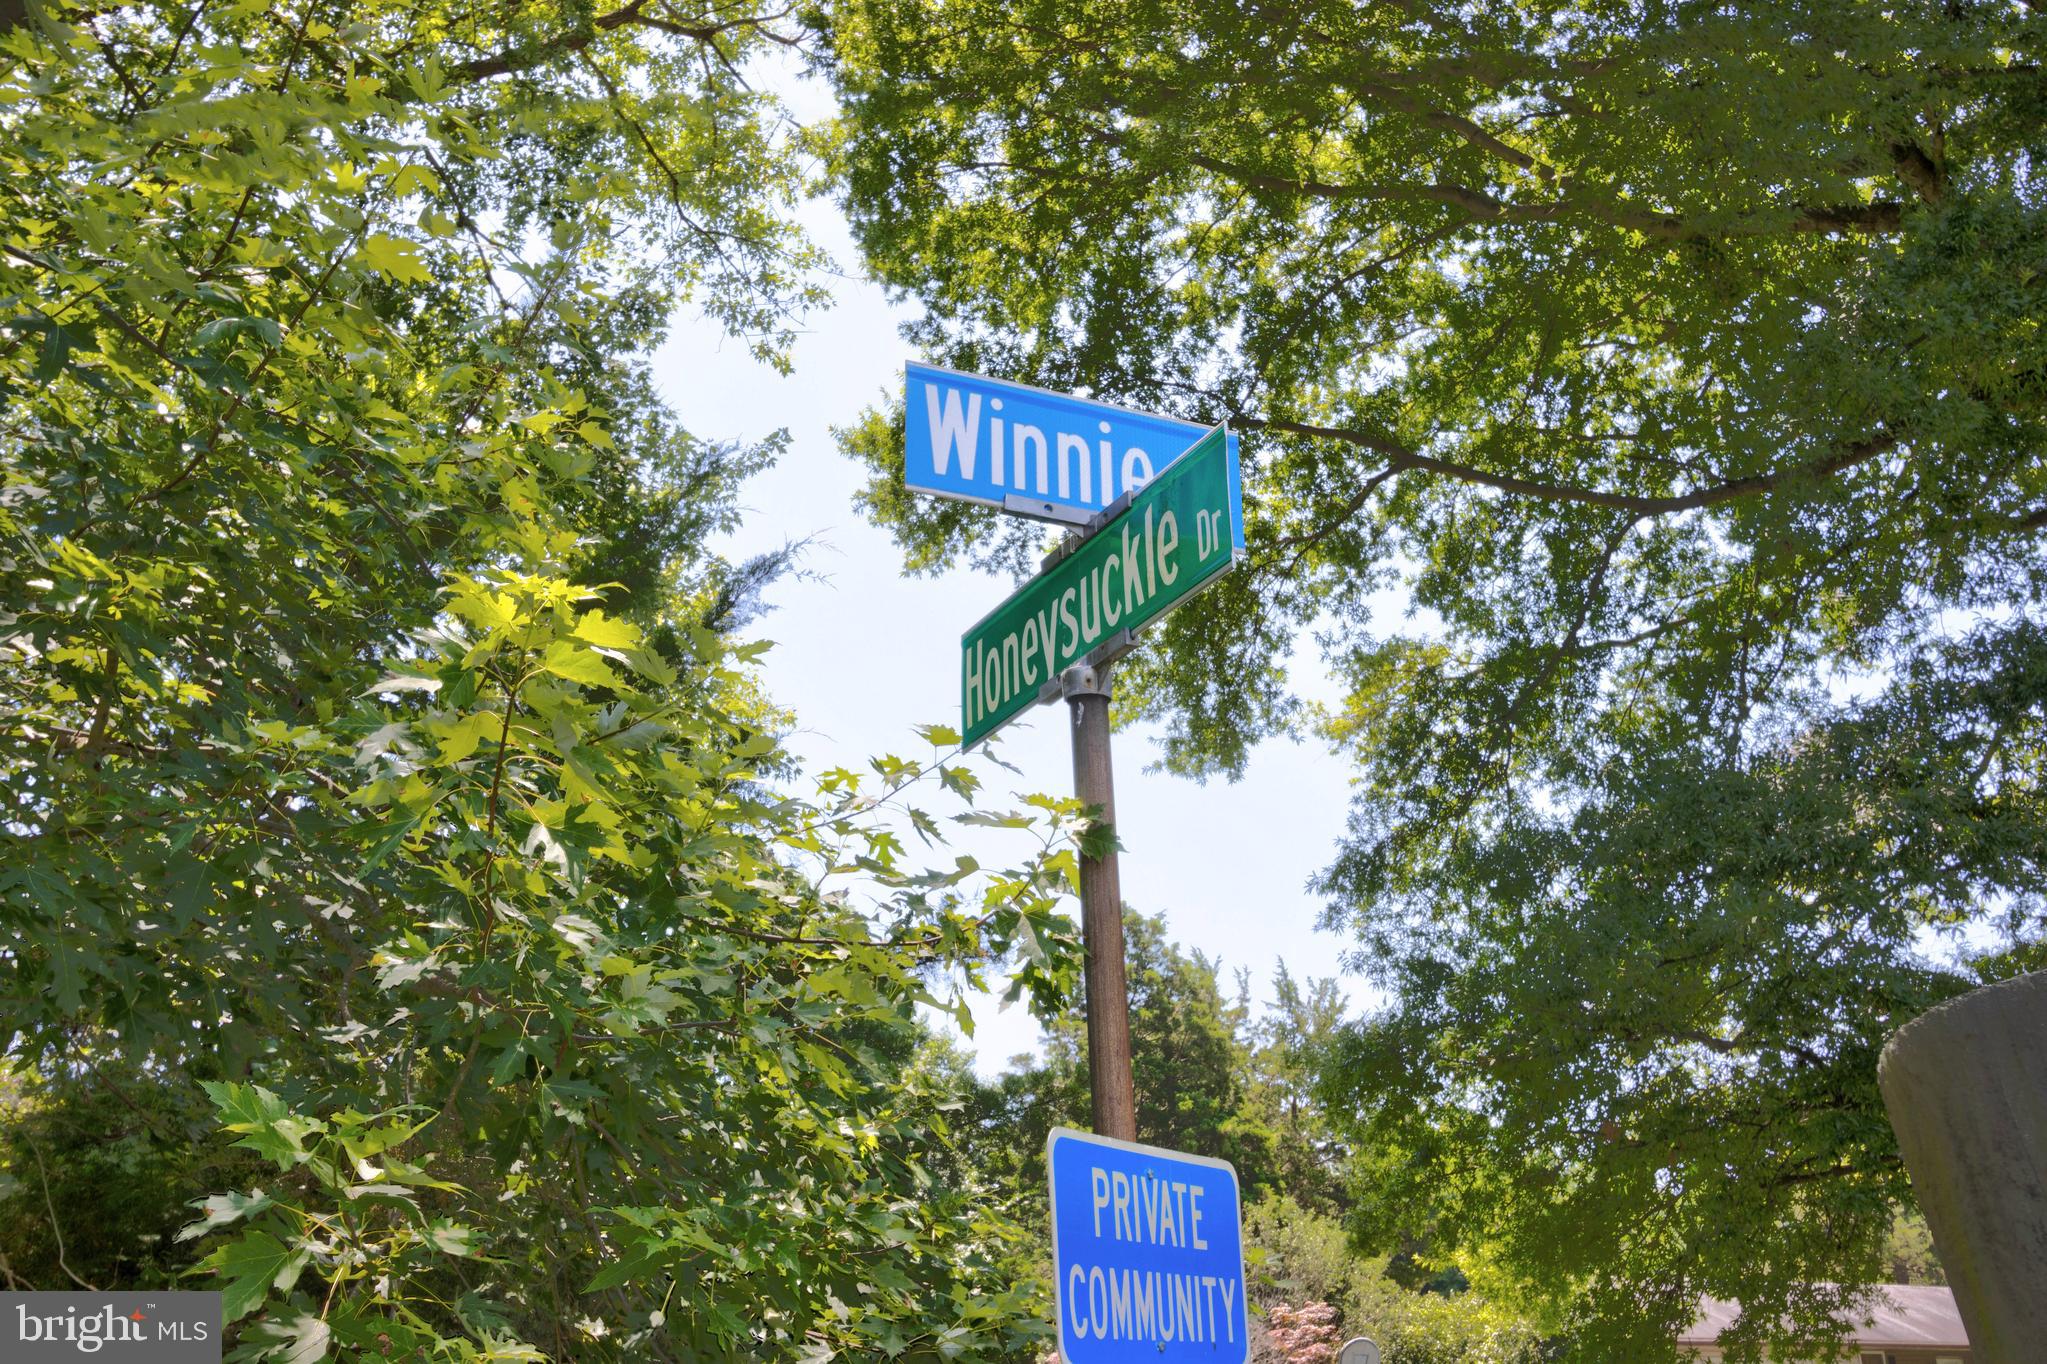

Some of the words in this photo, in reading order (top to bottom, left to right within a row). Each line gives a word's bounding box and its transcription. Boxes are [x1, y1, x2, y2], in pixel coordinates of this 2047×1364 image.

[924, 383, 1154, 507] Winnie
[965, 503, 1178, 730] Honeysuckle
[1197, 508, 1221, 562] Dr
[1092, 1167, 1207, 1250] PRIVATE
[1069, 1264, 1235, 1343] COMMUNITY
